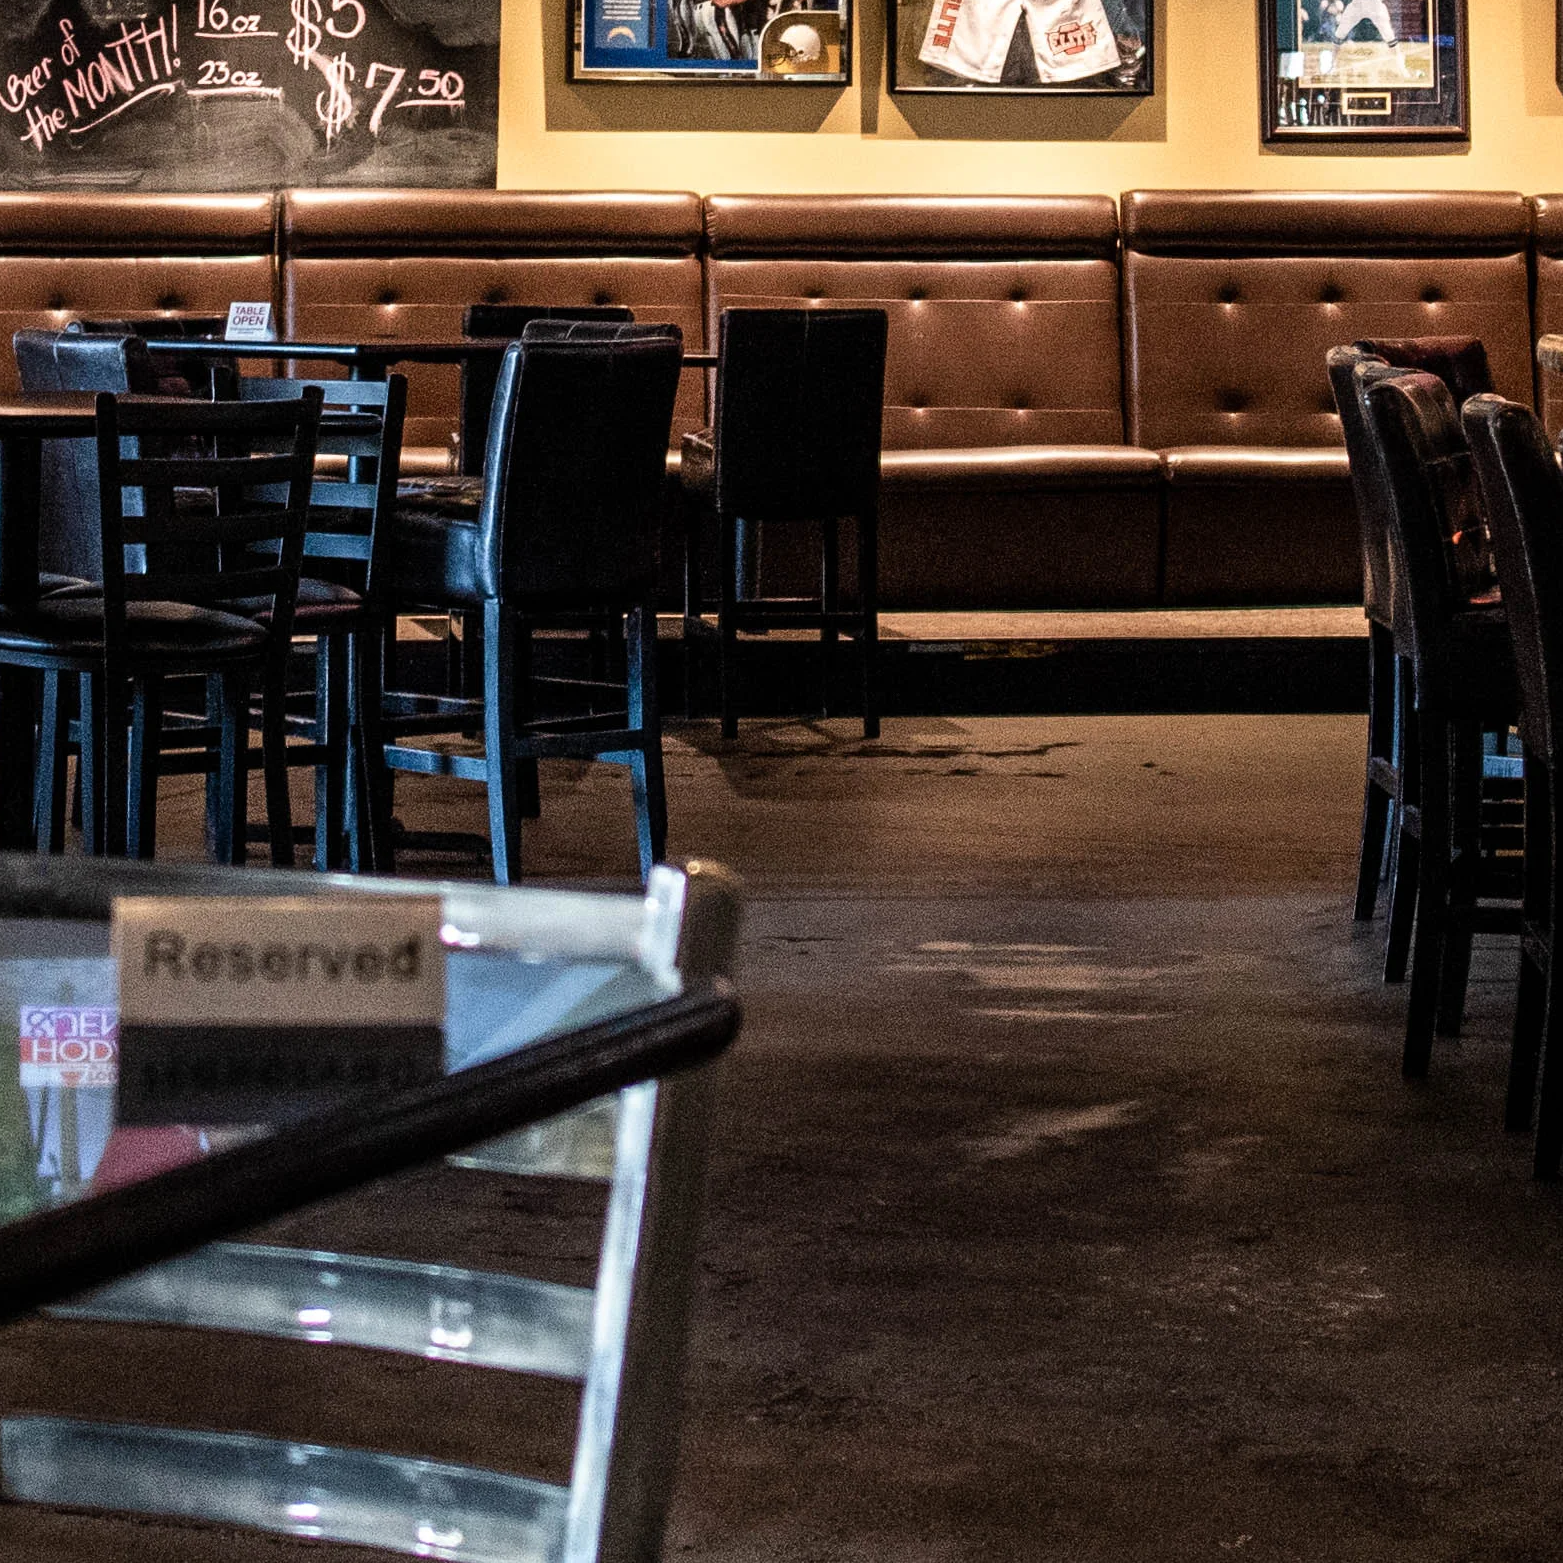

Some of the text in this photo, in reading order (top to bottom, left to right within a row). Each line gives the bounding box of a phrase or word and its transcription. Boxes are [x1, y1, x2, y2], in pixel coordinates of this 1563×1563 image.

[64, 3, 183, 118] MONTH!
[233, 316, 264, 326] OPEN
[235, 306, 266, 316] TABLE
[143, 929, 423, 985] Reserved
